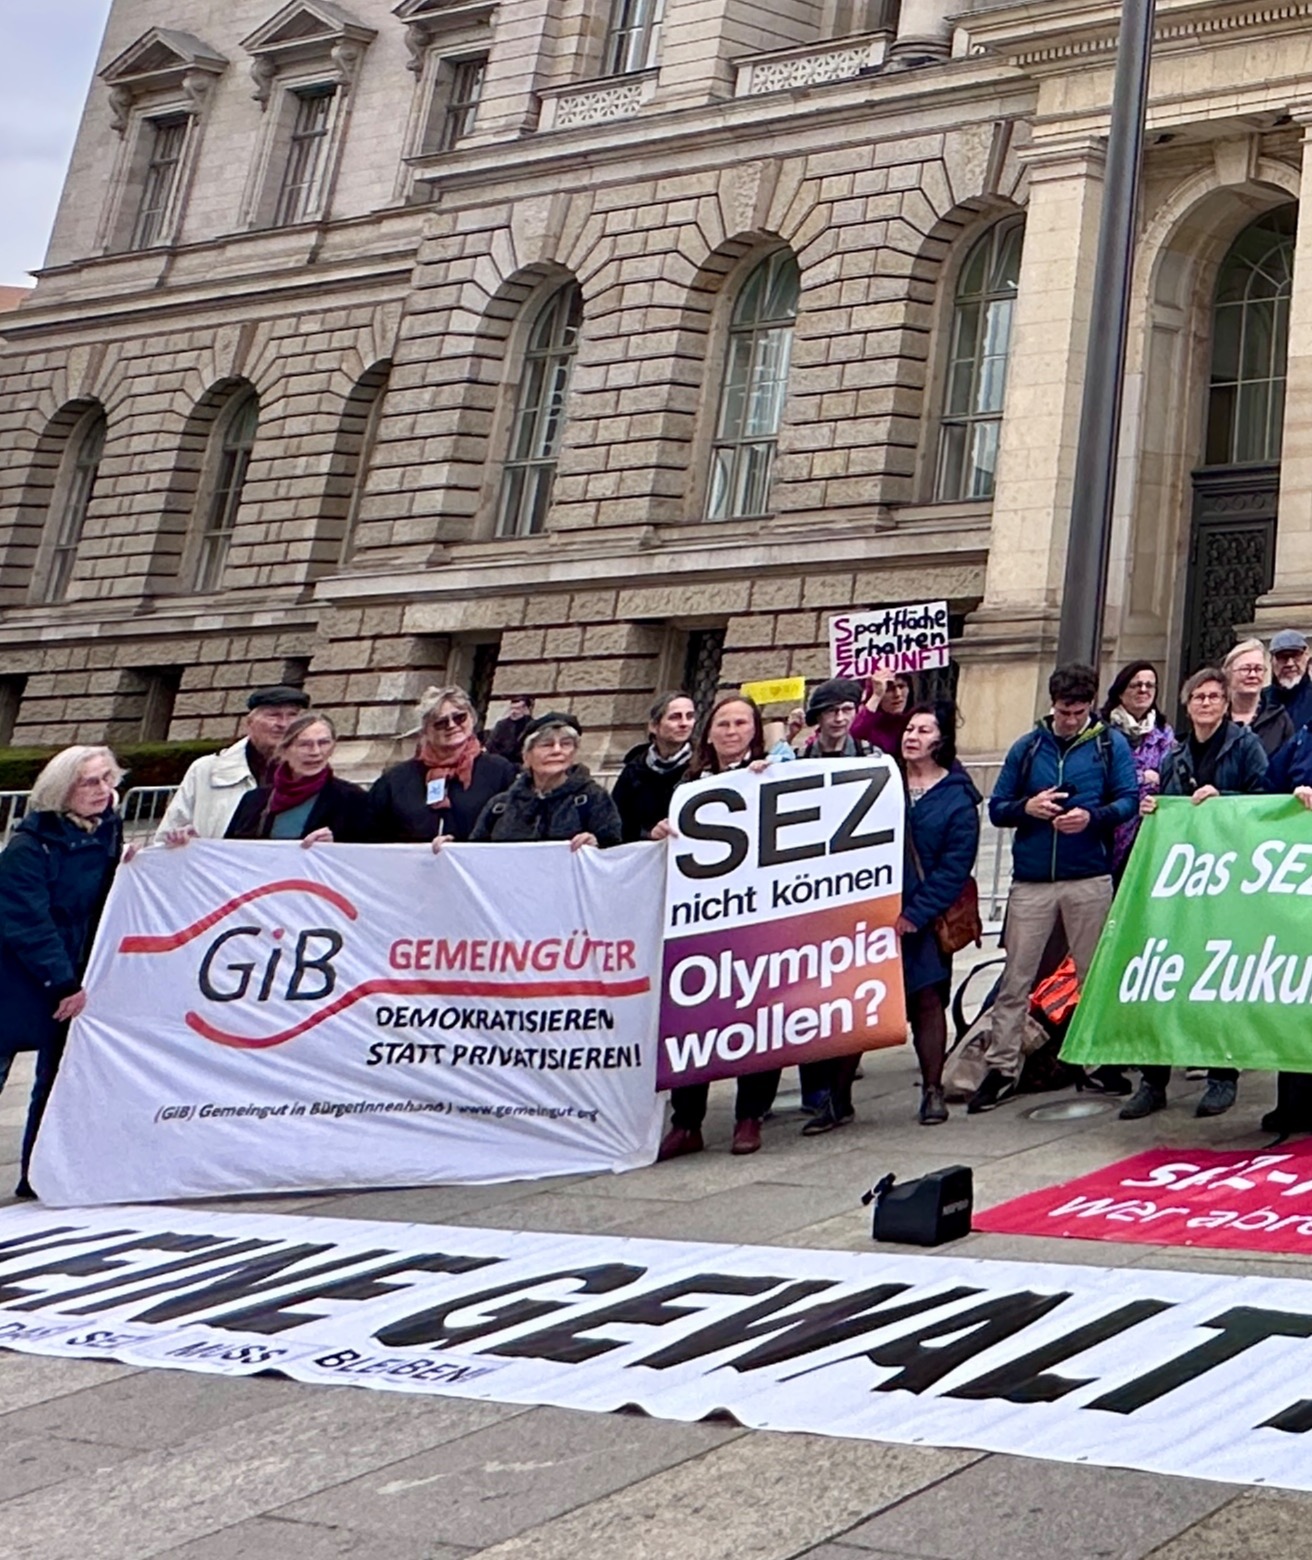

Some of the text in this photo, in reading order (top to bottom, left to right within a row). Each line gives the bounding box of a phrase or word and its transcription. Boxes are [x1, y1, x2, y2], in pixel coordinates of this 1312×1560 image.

[835, 632, 946, 662] Erhalten
[835, 645, 950, 679] ZUKUNFT
[675, 765, 896, 880] SEZ
[1151, 842, 1238, 899] Das
[671, 863, 893, 927] nicht können
[198, 926, 344, 1002] GiB
[388, 929, 638, 973] GEMEINGÜTER
[668, 921, 900, 1010] Olympia
[1118, 937, 1186, 1004] die
[375, 1005, 615, 1033] DEMOKRATISIEREN
[664, 979, 887, 1074] wollen?
[365, 1041, 643, 1070] STATT PRIVATISIEREN!
[199, 1102, 288, 1119] Gemeingut
[290, 1101, 305, 1116] in
[1048, 1195, 1193, 1224] Wer
[163, 1340, 289, 1365] MUSS
